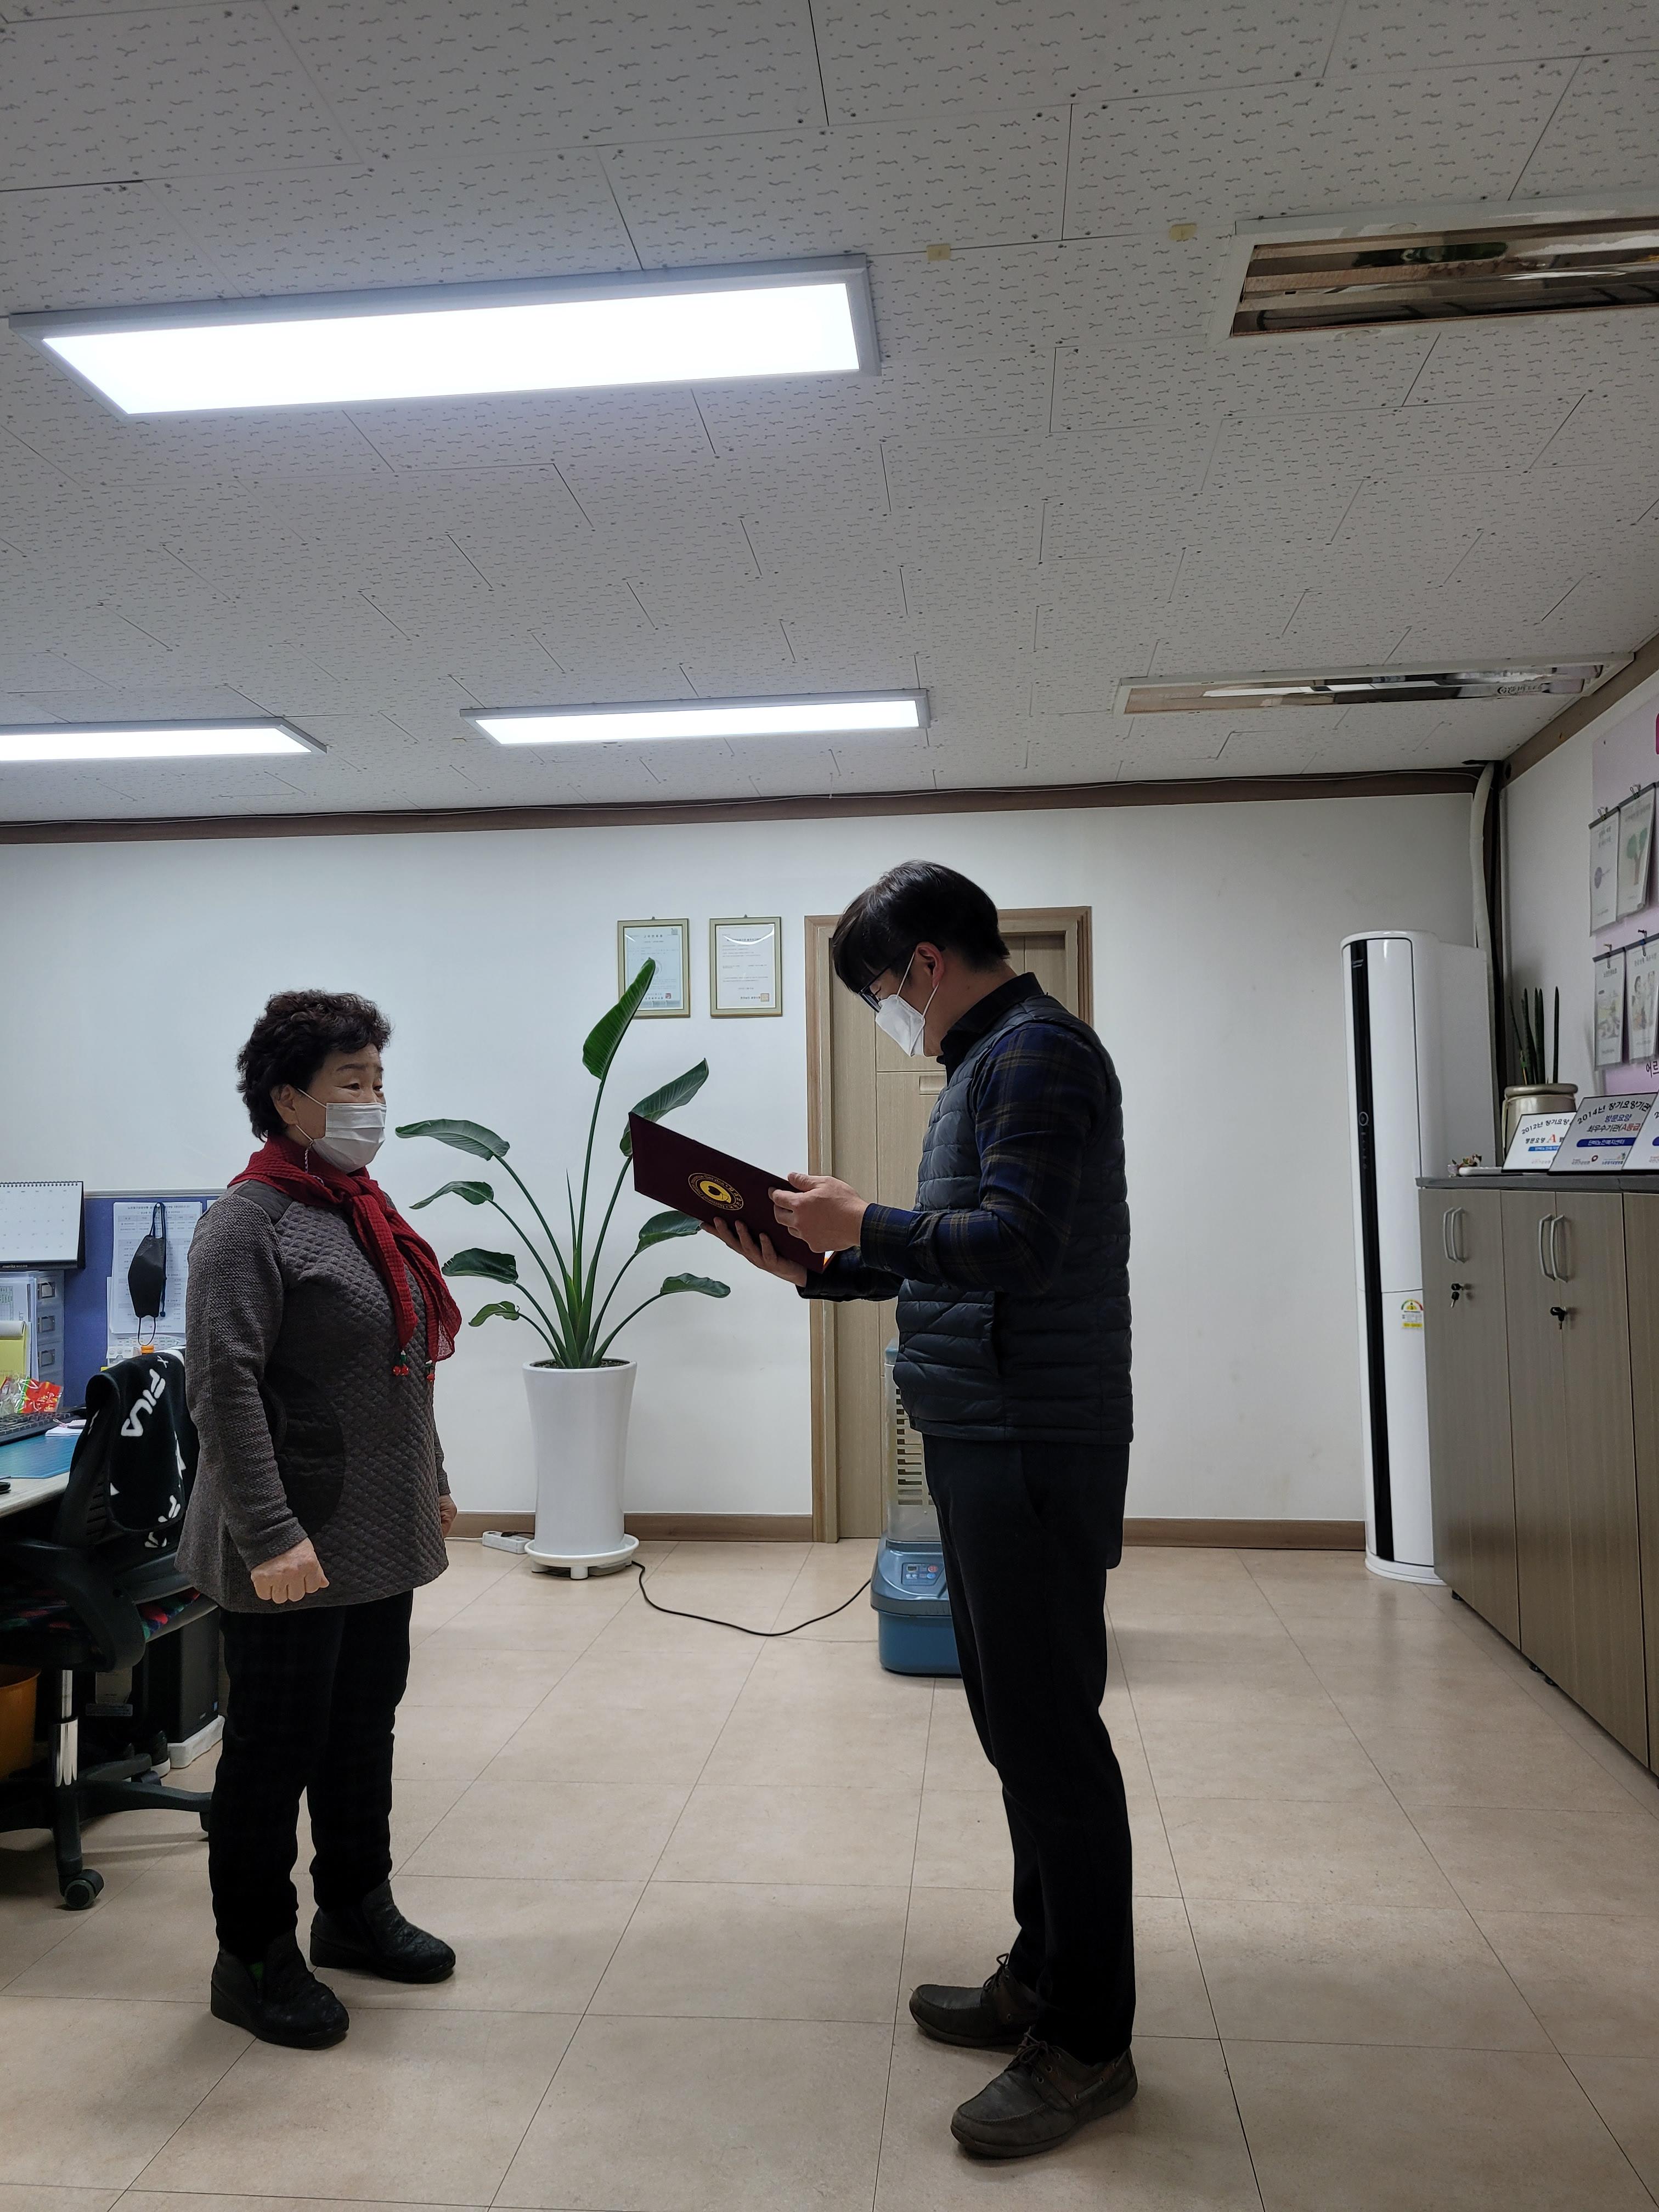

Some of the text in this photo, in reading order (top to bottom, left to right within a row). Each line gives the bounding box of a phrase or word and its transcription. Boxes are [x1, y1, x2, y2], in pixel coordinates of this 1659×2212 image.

[1577, 1101, 1651, 1124] 2014년 장기요양기관
[1605, 1114, 1632, 1122] 방문요양
[1521, 1122, 1543, 1135] 2012년
[1587, 1123, 1643, 1132] 최우수기관(A등급
[1547, 1134, 1556, 1143] A
[121, 1368, 166, 1437] FILA
